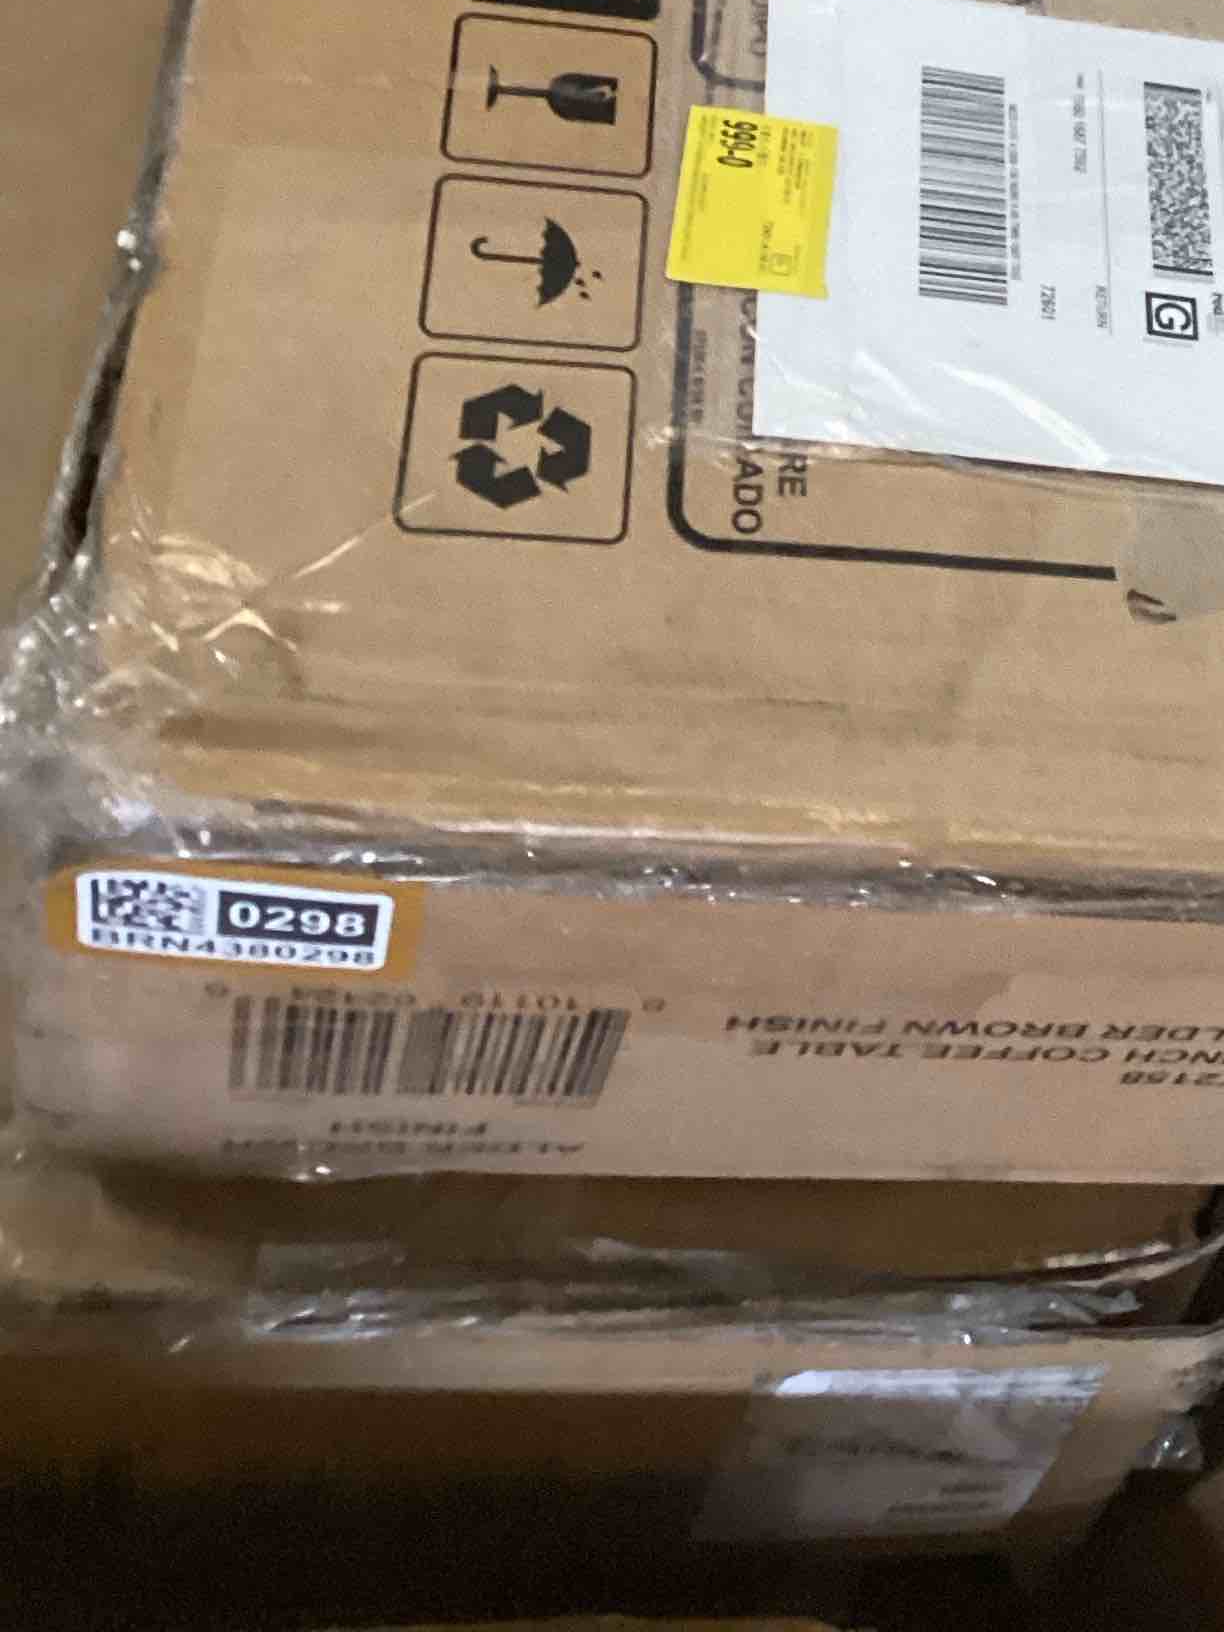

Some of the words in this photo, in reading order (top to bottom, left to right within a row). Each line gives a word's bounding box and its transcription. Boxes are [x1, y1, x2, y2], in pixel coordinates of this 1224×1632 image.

[1154, 302, 1192, 331] G
[227, 900, 366, 938] 0298
[723, 1016, 888, 1035] FINISH
[903, 1020, 1089, 1039] BROWN
[749, 1041, 901, 1058] TABLE
[922, 1044, 1113, 1062] COFFEE
